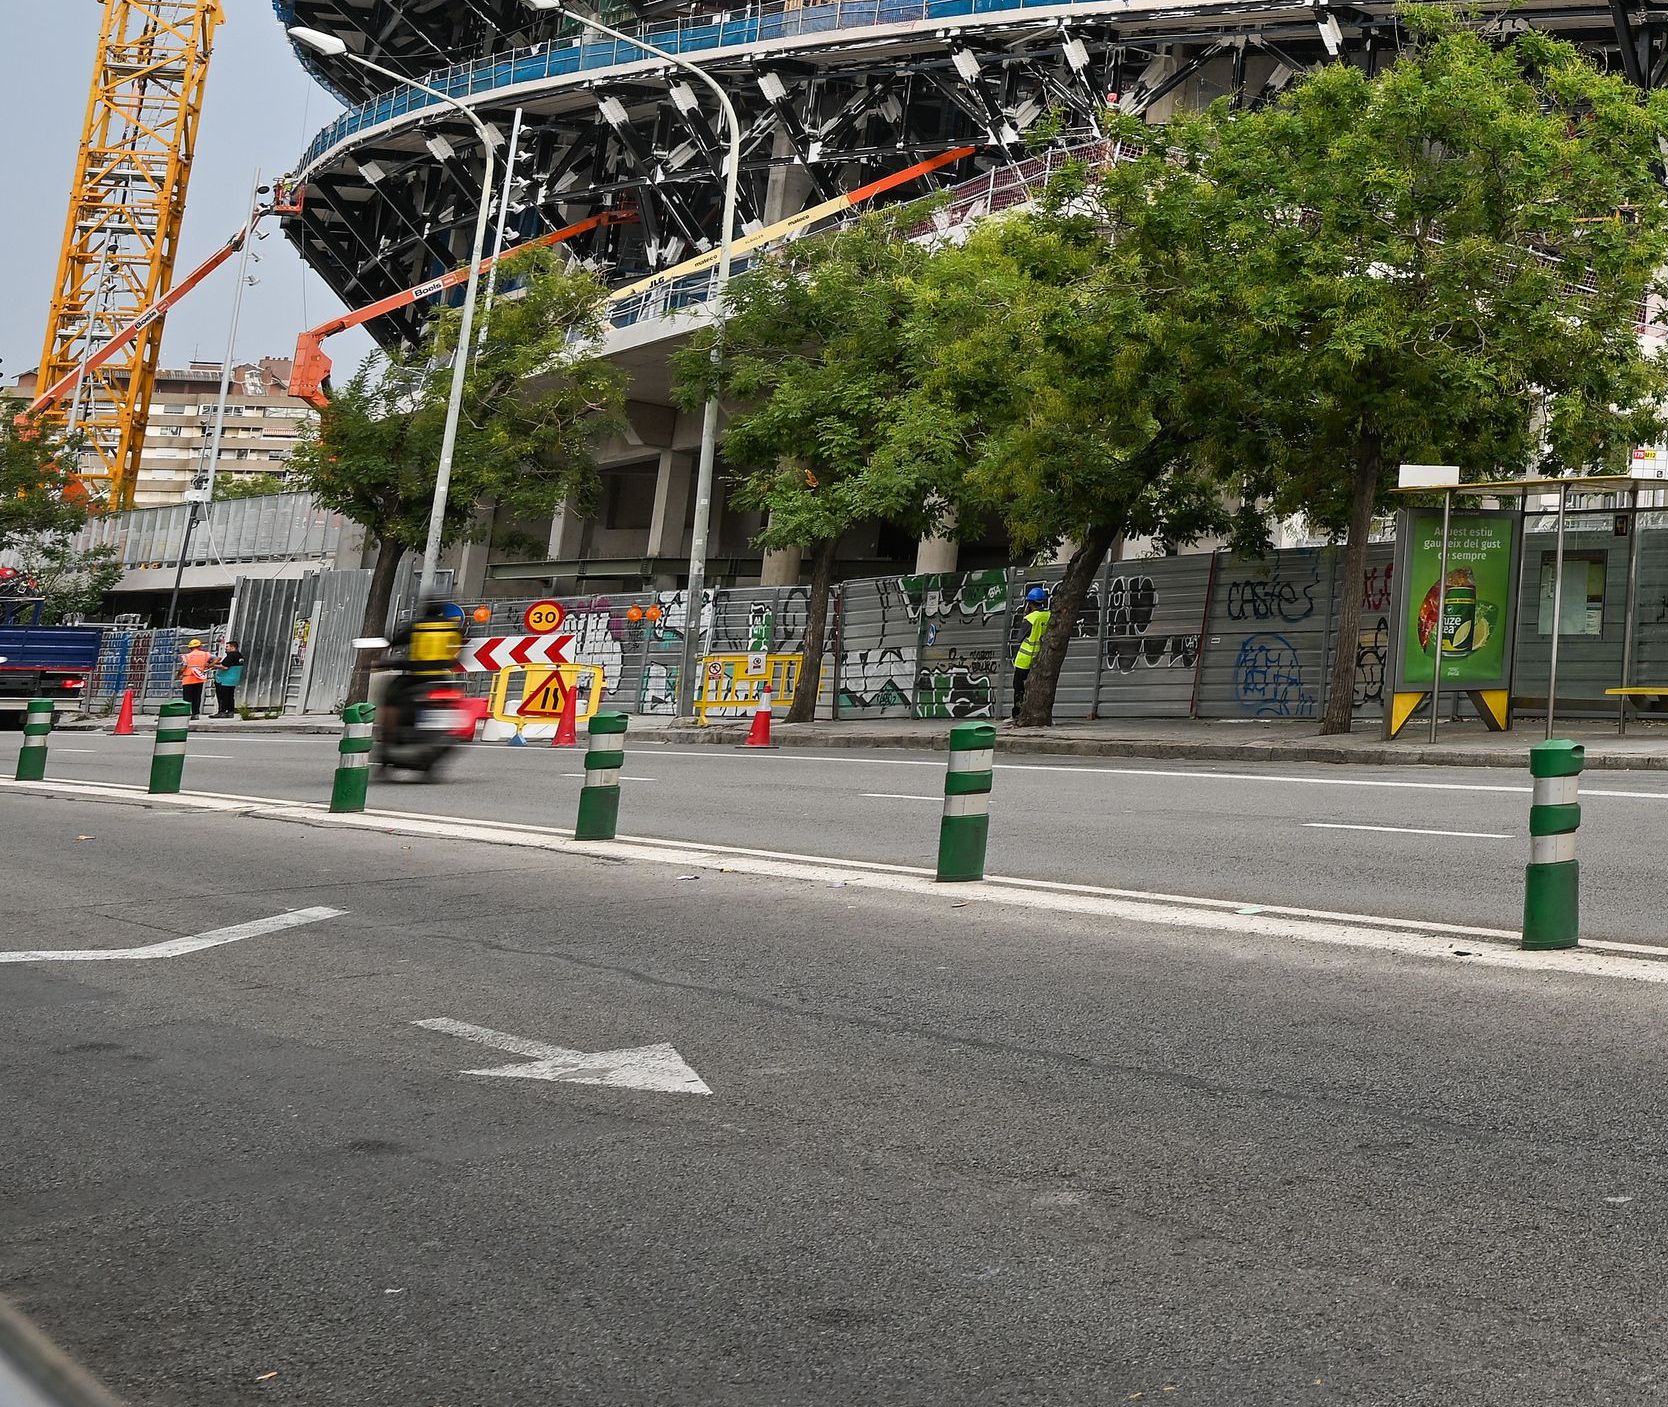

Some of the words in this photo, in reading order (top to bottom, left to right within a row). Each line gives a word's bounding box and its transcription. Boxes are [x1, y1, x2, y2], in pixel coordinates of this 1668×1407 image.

[649, 276, 665, 288] JLG
[415, 282, 442, 297] Boels
[135, 311, 157, 329] Boels
[1469, 526, 1493, 537] estiu
[1424, 538, 1462, 549] gaueix
[1463, 538, 1479, 548] del
[1481, 539, 1501, 550] gust
[1451, 552, 1487, 561] sempre
[532, 611, 556, 624] 30
[1443, 616, 1462, 625] uze
[1443, 625, 1455, 634] ea
